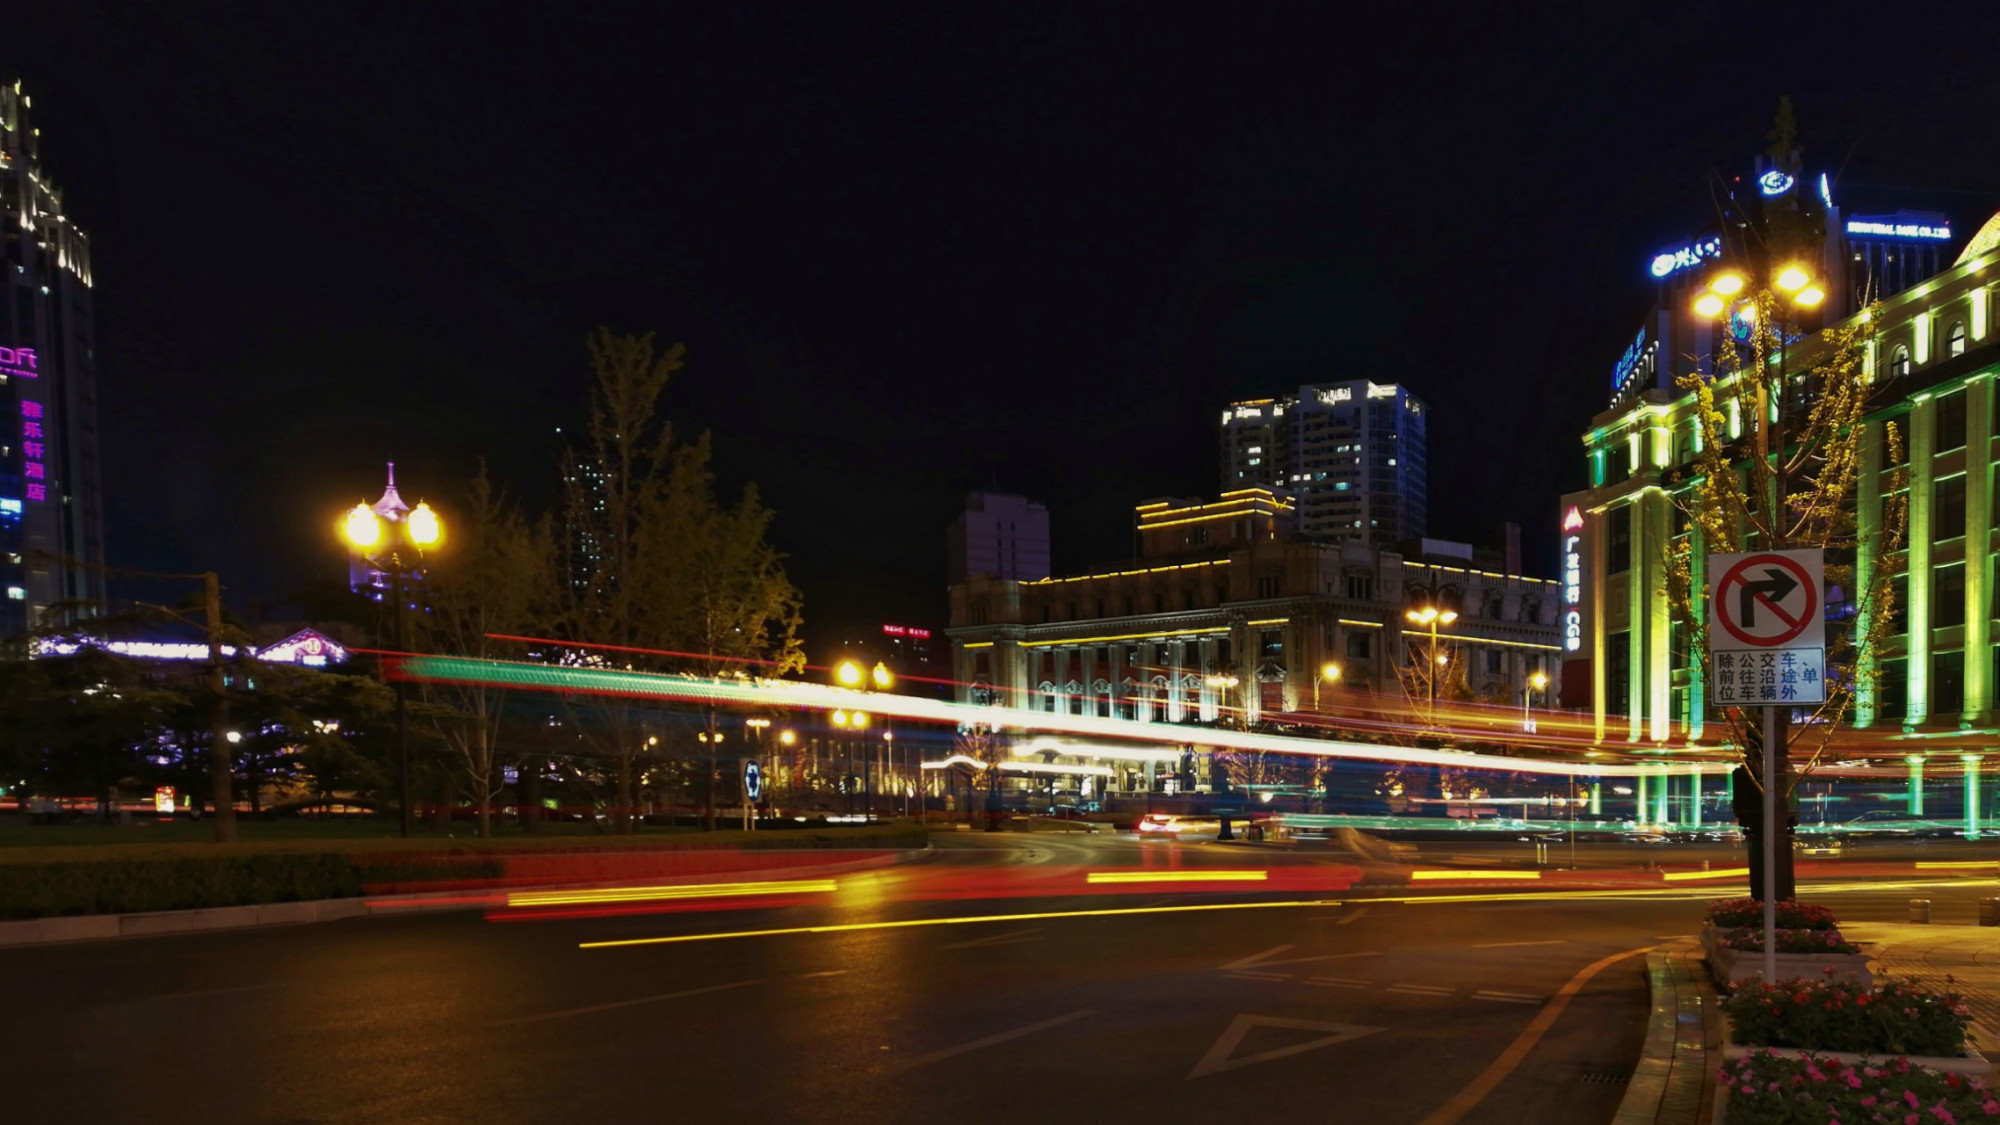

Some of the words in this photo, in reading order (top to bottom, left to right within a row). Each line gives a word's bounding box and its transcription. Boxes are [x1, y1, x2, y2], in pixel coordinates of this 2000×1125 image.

[1718, 668, 1819, 685] 前往沿途单
[1719, 684, 1798, 701] 位车辆外
